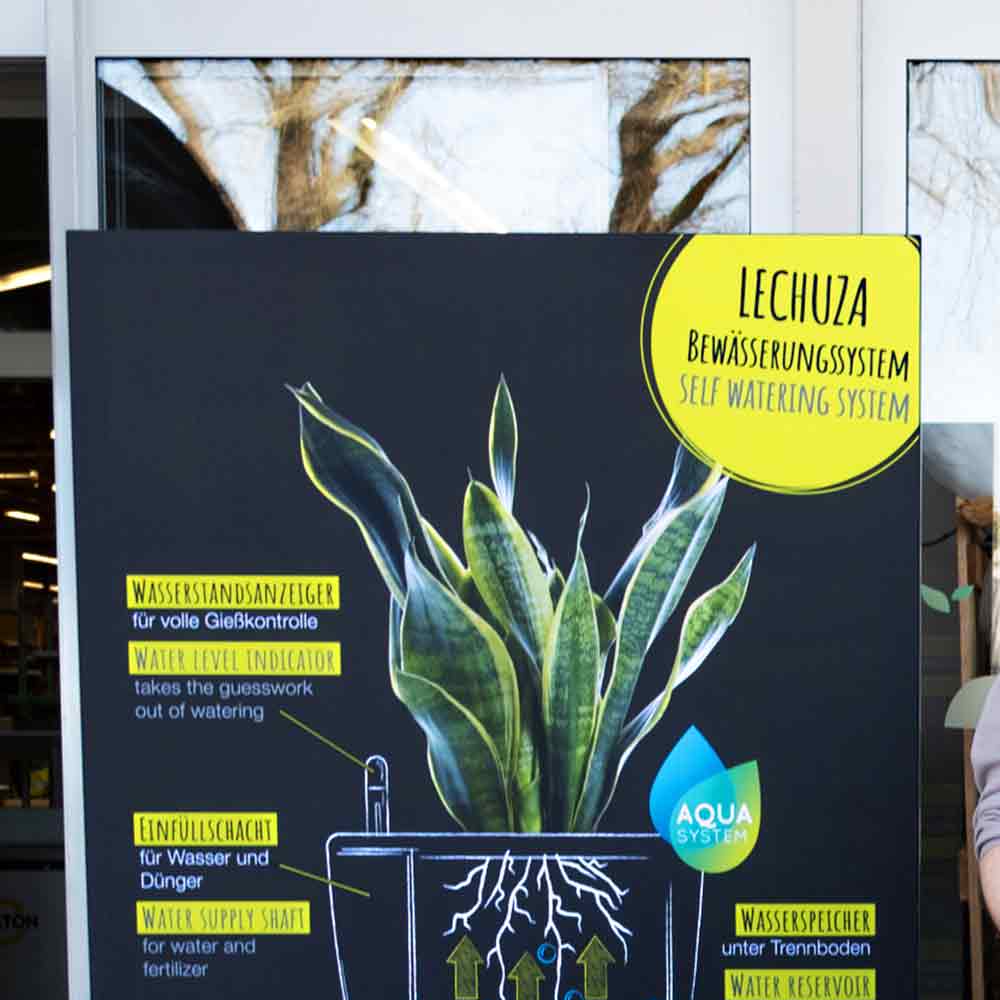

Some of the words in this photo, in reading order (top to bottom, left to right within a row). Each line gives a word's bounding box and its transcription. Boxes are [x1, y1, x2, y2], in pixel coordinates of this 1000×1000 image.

[739, 265, 868, 328] LECHUZA
[680, 373, 721, 407] SELF
[727, 377, 829, 416] WATERING
[836, 387, 910, 424] SYSTEM
[133, 612, 155, 630] für
[160, 612, 199, 630] volle
[205, 612, 318, 630] Gießkontrolle
[134, 646, 185, 671] WATER
[194, 648, 238, 672] LEVEL
[247, 648, 335, 672] INDICATOR
[135, 680, 181, 696] takes
[187, 680, 213, 696] the
[219, 680, 313, 699] guesswork
[135, 704, 163, 719] out
[169, 703, 185, 719] of
[191, 704, 264, 722] watering
[676, 803, 752, 829] AQUA
[139, 815, 273, 842] EINFÜLLSCHACHT
[677, 830, 747, 844] SYSTEM
[139, 849, 162, 866] für
[167, 850, 231, 866] Wasser
[237, 850, 269, 866] und
[141, 872, 203, 893] Dünger
[142, 906, 192, 931] WATER
[200, 907, 254, 930] SUPPLY
[262, 907, 305, 930] SHAFT
[143, 939, 166, 954] for
[171, 940, 217, 954] water
[224, 939, 256, 954] and
[722, 941, 766, 956] unter
[770, 939, 871, 956] Trennboden
[143, 962, 208, 977] fertilizer
[731, 973, 779, 998] WATER
[789, 975, 870, 997] RESERVOIR
